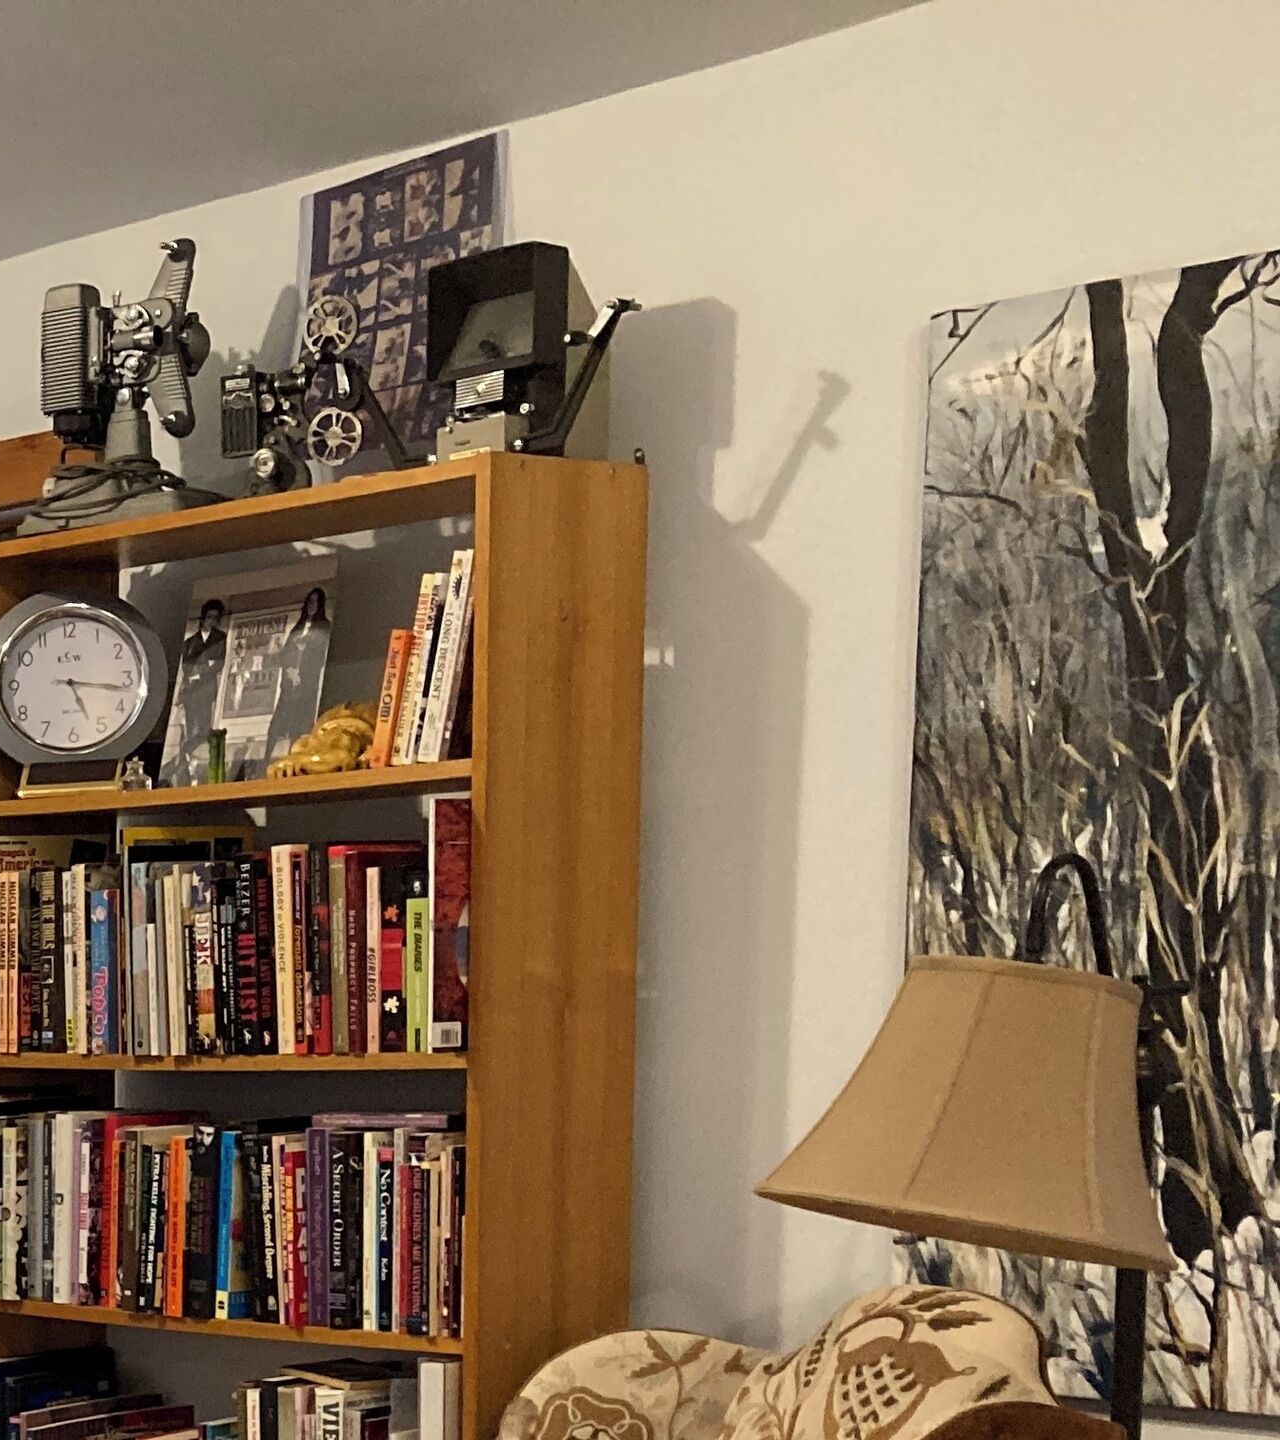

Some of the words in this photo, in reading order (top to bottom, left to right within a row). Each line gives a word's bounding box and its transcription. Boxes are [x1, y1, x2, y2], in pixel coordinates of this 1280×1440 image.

[38, 632, 47, 648] 11
[63, 622, 76, 638] 12
[441, 611, 454, 645] LONG
[18, 651, 33, 667] 10
[113, 643, 124, 659] 2
[8, 679, 20, 696] 9
[122, 670, 134, 688] 3
[431, 643, 450, 701] DESCENT
[18, 705, 28, 721] 8
[115, 698, 125, 714] 4
[40, 720, 51, 738] 7
[68, 727, 79, 743] 6
[96, 716, 108, 733] 5
[8, 881, 16, 924] NUCLEAR
[239, 863, 252, 916] BELZER
[274, 866, 284, 911] BIOLOGY
[414, 911, 423, 931] THE
[237, 933, 255, 967] HIT
[276, 923, 286, 973] VIOLENCE
[413, 933, 423, 973] DIARIES
[348, 942, 357, 992] PROPHECY
[368, 947, 377, 1004] #GIRLBOSS
[238, 976, 257, 1022] LIST
[349, 998, 357, 1030] FAILS
[151, 1153, 160, 1181] PETRA
[332, 1146, 343, 1158] A
[149, 1181, 158, 1205] KELLY
[331, 1162, 344, 1215] SECRET
[379, 1167, 390, 1190] No
[262, 1213, 274, 1246] Second
[379, 1191, 390, 1241] Contest
[412, 1191, 421, 1241] CHILDREN
[146, 1245, 154, 1261] FOR
[332, 1217, 344, 1267] ORDER
[412, 1244, 420, 1261] ARE
[263, 1247, 275, 1279] Degree
[411, 1264, 420, 1316] WATCHING
